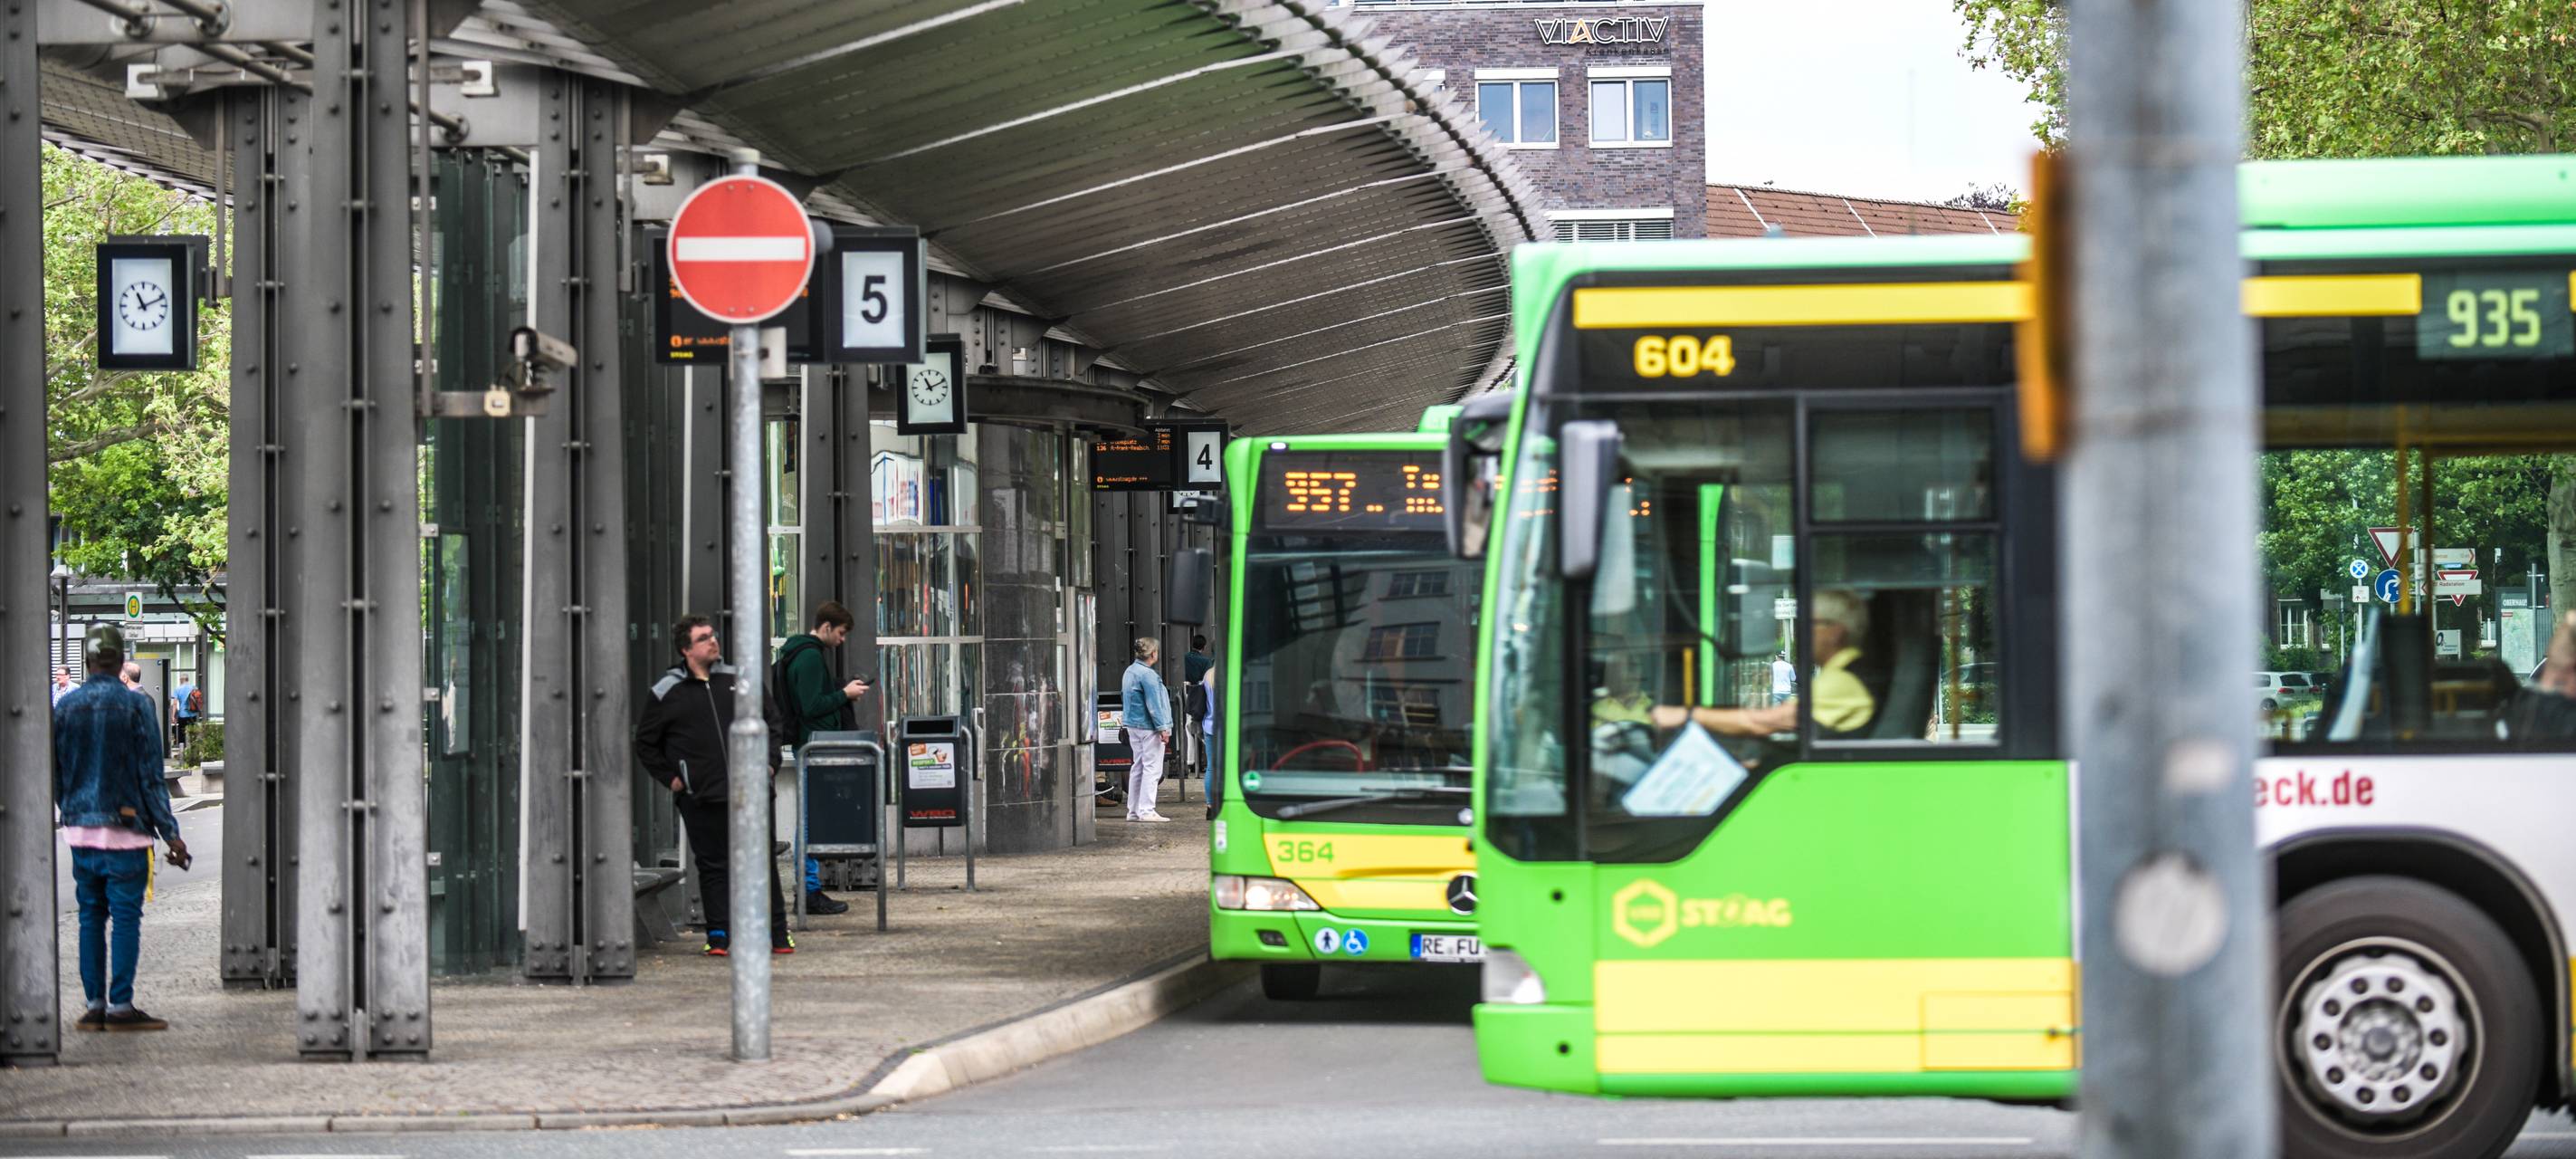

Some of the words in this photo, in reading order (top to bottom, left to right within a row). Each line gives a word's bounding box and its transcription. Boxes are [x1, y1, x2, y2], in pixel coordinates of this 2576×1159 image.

[1534, 16, 1669, 44] VIACTIV
[861, 274, 888, 324] 5
[2447, 289, 2542, 348] 935
[1633, 334, 1736, 378] 604
[1197, 443, 1213, 471] 4
[1276, 840, 1335, 864] 364
[1681, 894, 1793, 928] STOAG
[1421, 937, 1445, 955] RE
[1455, 937, 1480, 956] FU
